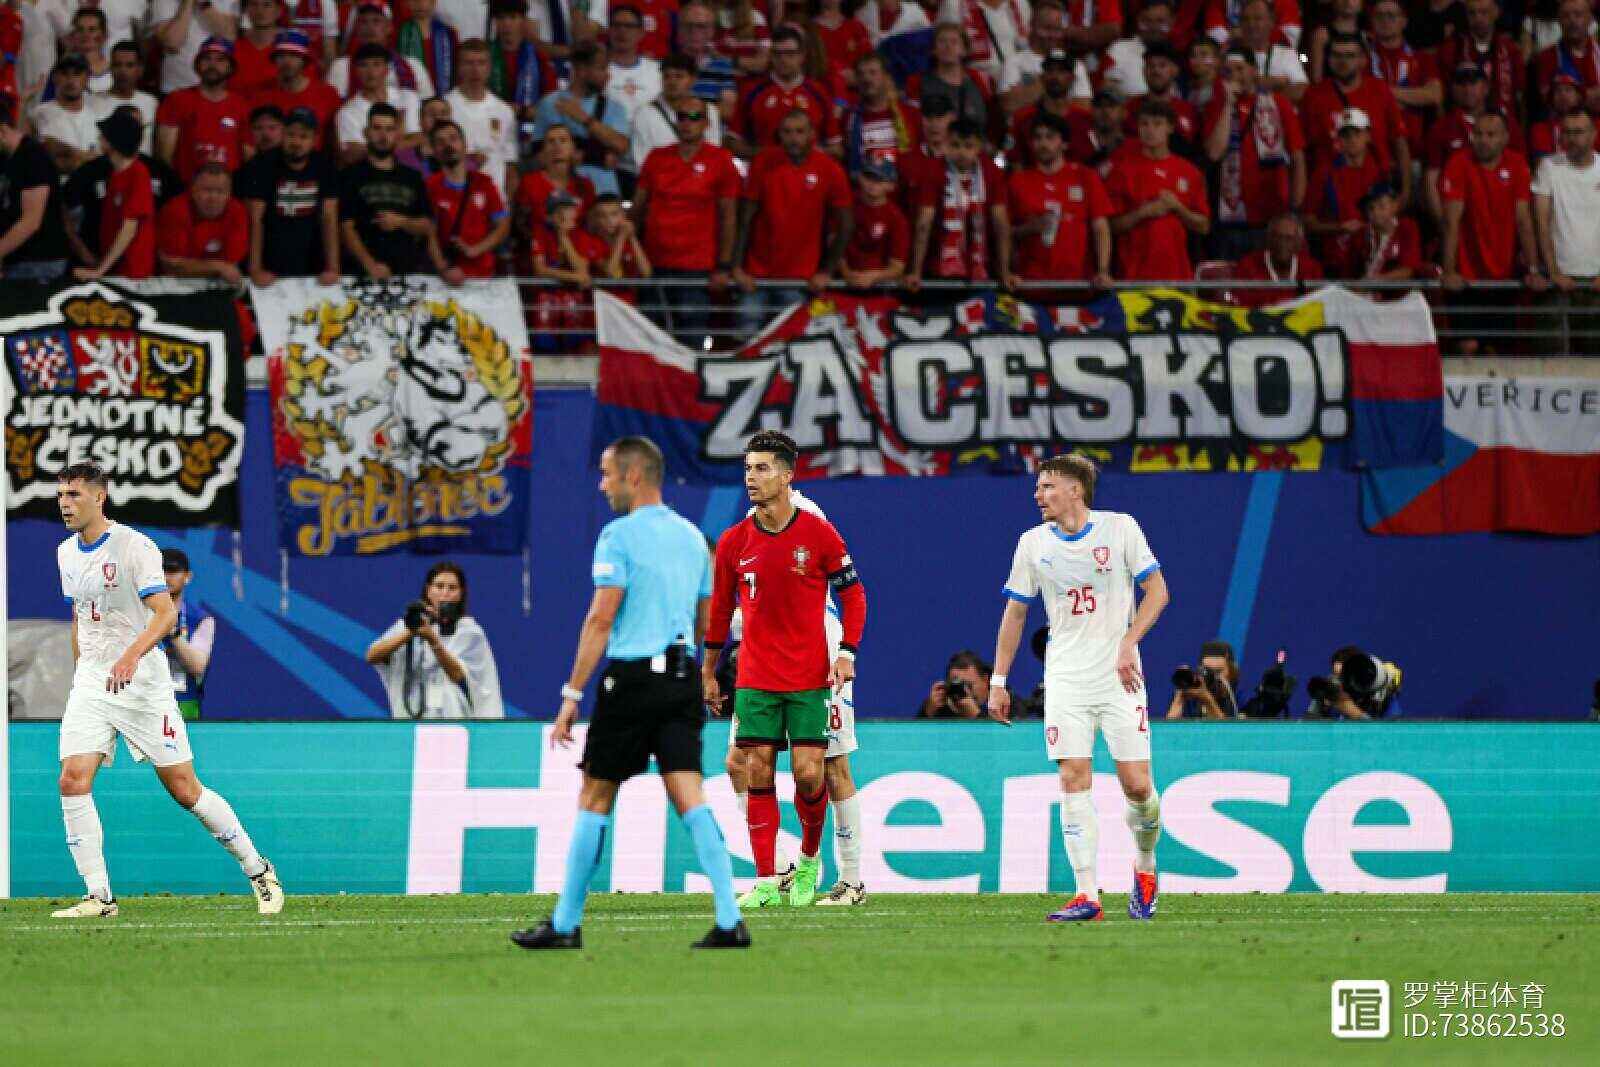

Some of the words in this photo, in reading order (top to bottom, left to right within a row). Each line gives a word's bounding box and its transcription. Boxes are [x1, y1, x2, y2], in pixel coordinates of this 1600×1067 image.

[702, 334, 874, 459] ZA
[891, 316, 1348, 445] ČESKO!
[12, 395, 205, 436] JEDNOTNÉ
[36, 427, 182, 478] ČESKO
[743, 572, 756, 599] 7
[1067, 584, 1097, 615] 25
[162, 714, 176, 739] 4
